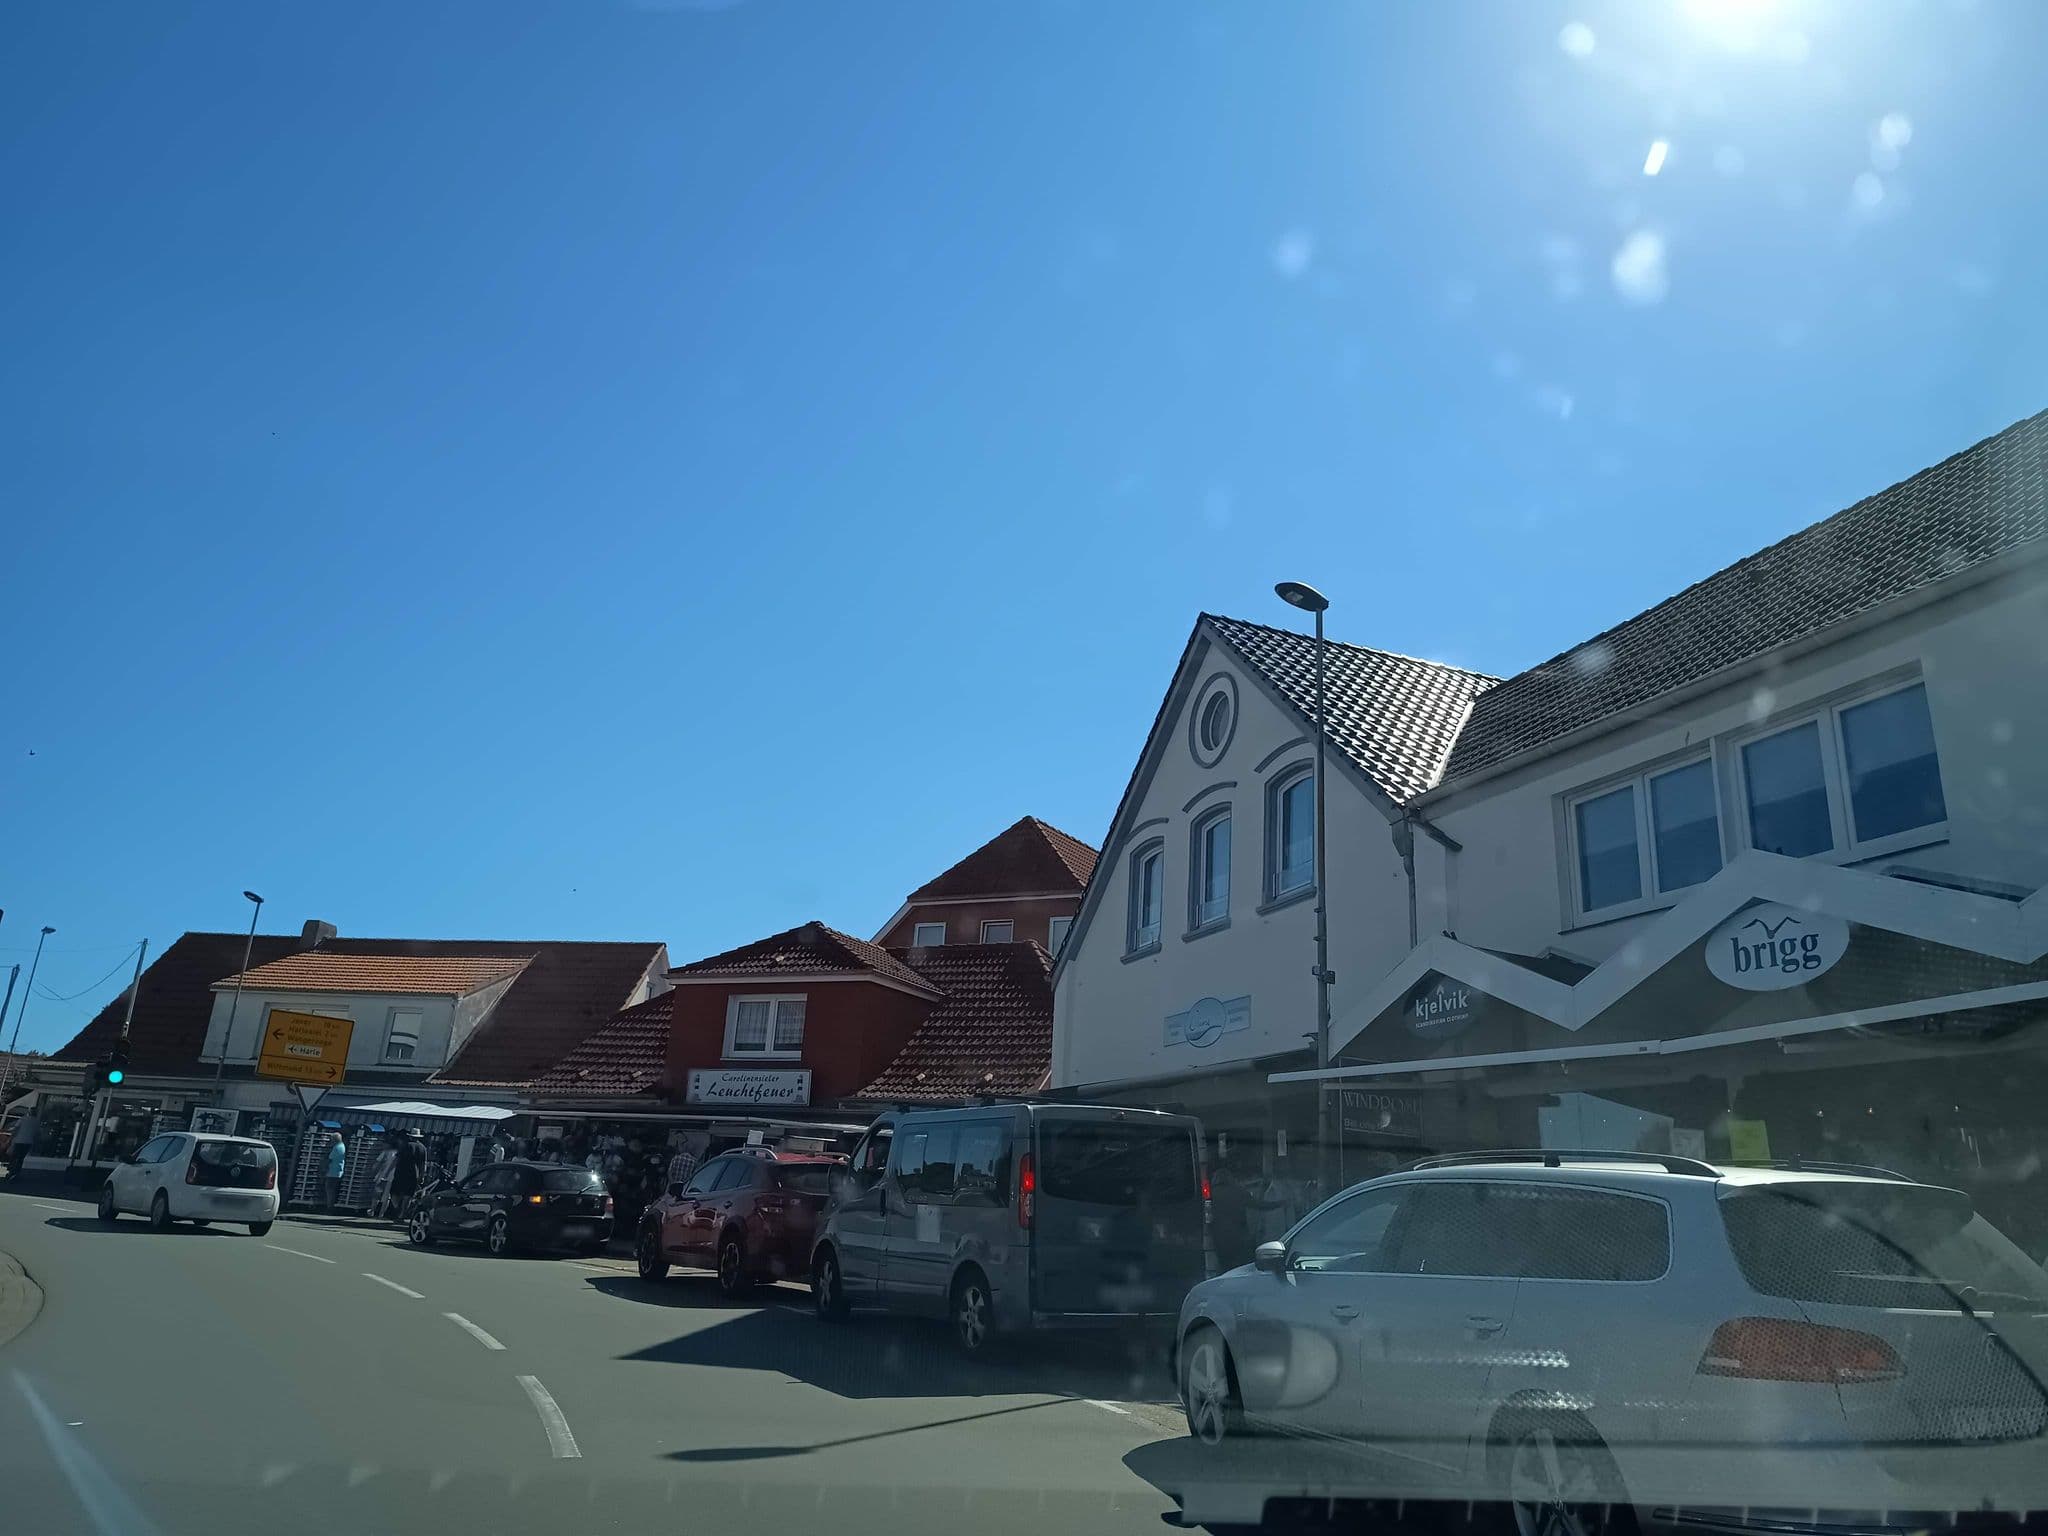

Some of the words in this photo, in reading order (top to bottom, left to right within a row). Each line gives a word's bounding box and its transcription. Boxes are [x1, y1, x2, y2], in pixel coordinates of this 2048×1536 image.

[1730, 933, 1822, 973] brigg
[1415, 989, 1468, 1021] kjelvik
[299, 1047, 321, 1056] Harle
[706, 1081, 794, 1103] Leuchtfeuer
